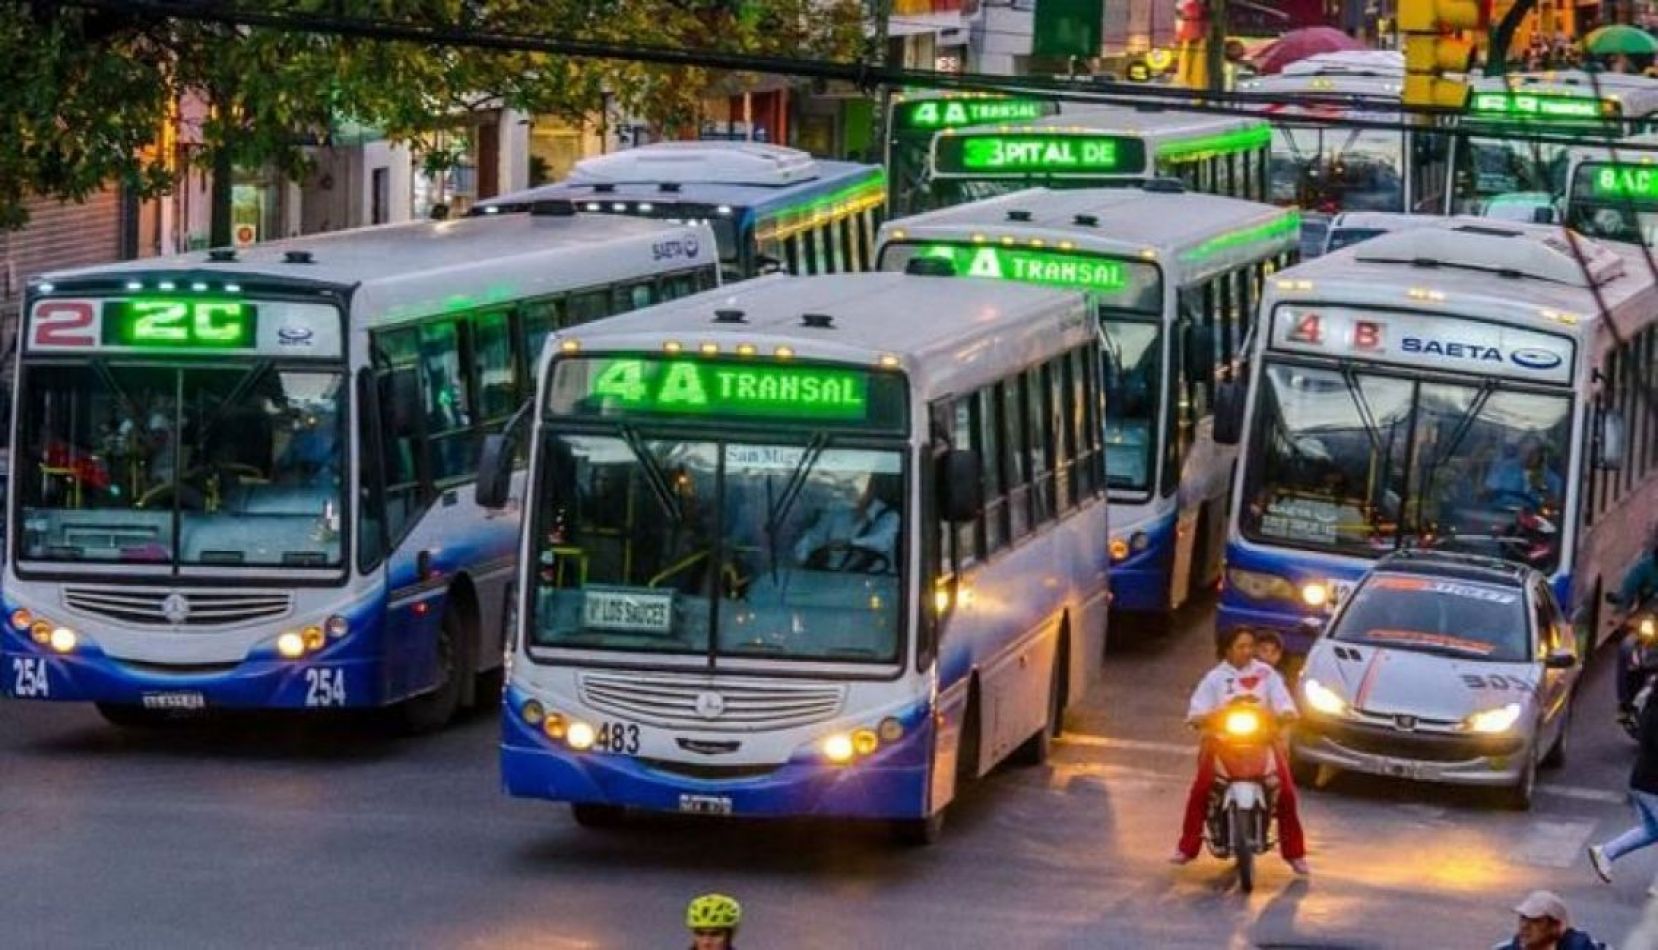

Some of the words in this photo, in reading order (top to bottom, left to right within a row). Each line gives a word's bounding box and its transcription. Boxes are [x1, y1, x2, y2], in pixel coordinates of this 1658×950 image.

[914, 102, 938, 123] 4
[944, 102, 967, 123] A
[970, 103, 1036, 118] TRANSAL
[1083, 142, 1115, 165] DE
[968, 246, 1002, 277] A
[1012, 256, 1125, 287] TRANSAL
[35, 302, 94, 345] 2
[133, 302, 241, 339] 2C
[1291, 314, 1321, 344] 4
[1354, 322, 1380, 349] B
[1401, 337, 1504, 363] SAETA
[596, 360, 646, 400] 4
[658, 362, 707, 404] A
[716, 371, 863, 404] TRANSAL
[14, 658, 49, 696] 254
[305, 668, 346, 706] 254
[597, 722, 639, 753] 483
